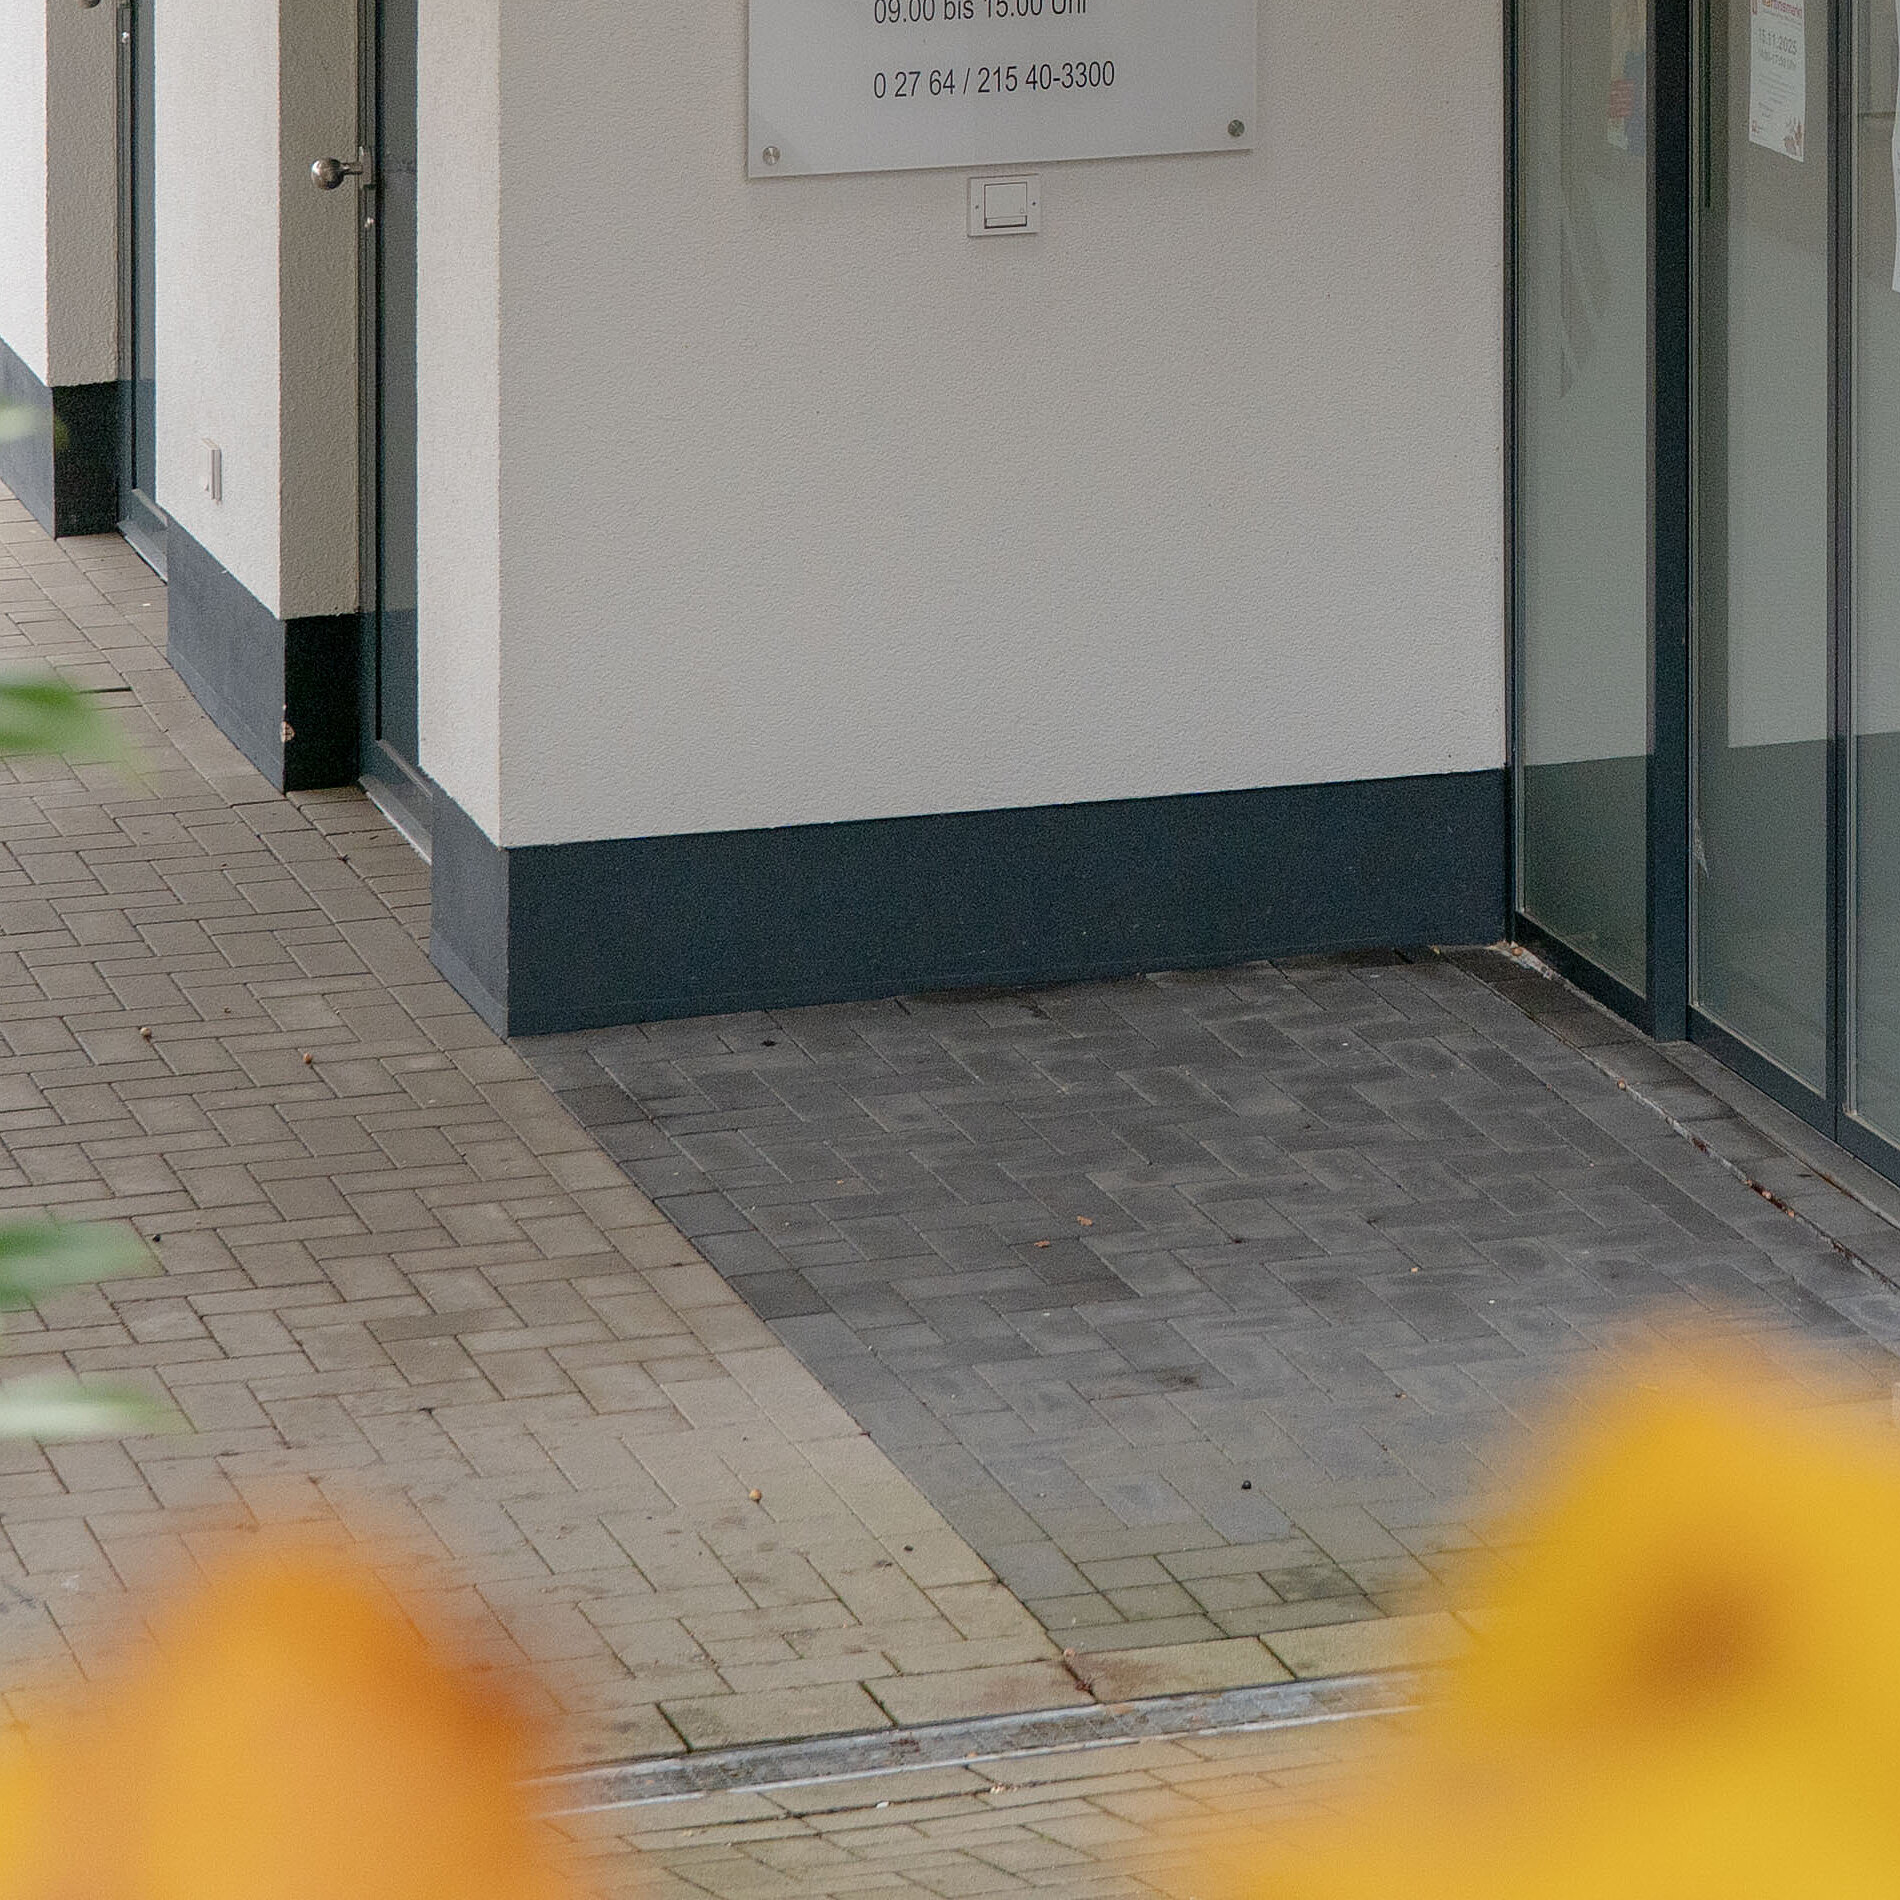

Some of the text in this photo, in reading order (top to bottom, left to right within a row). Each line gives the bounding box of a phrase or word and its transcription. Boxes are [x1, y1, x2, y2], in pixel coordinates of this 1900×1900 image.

[873, 59, 1115, 99] 0 27 64 / 215 40-3300
